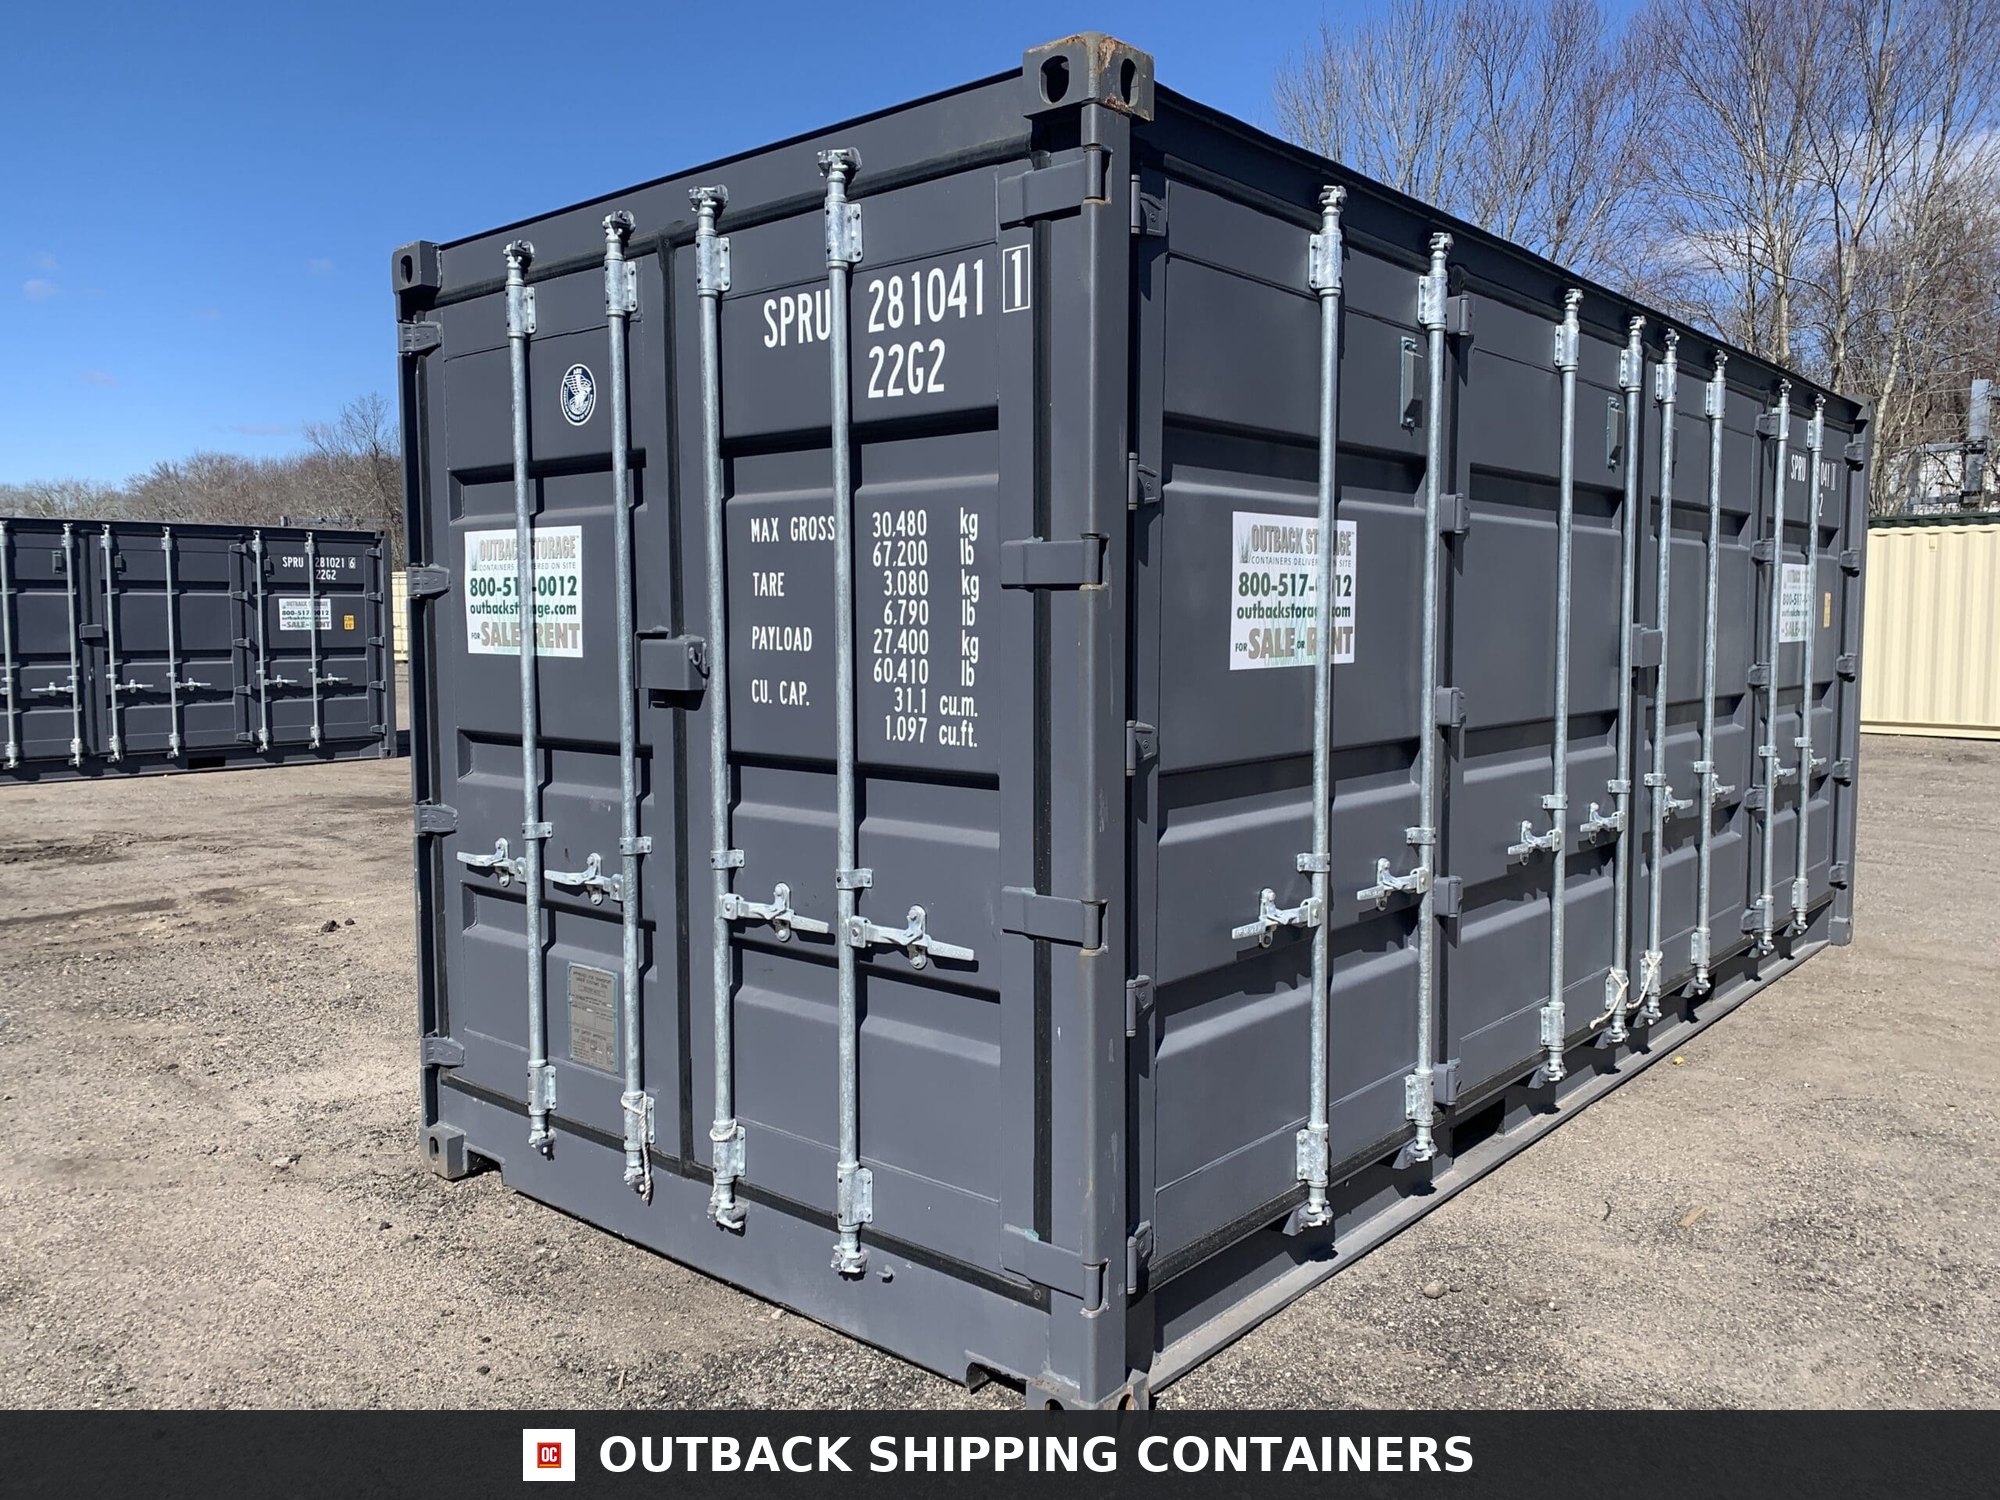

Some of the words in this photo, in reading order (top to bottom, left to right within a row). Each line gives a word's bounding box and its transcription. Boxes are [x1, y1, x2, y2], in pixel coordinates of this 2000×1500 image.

[763, 289, 831, 348] SPRU
[868, 259, 983, 333] 281041
[868, 338, 946, 398] 22G2
[751, 517, 779, 542] MAX
[790, 515, 835, 541] GROSS
[872, 510, 927, 538] 30,480
[960, 507, 978, 541] kg
[480, 538, 518, 561] OUTBAC
[873, 540, 928, 567] 67,200
[960, 538, 974, 565] lb
[1251, 524, 1304, 554] OUTBACK
[1306, 528, 1351, 556] STAGE
[282, 556, 304, 568] SPRU
[315, 557, 345, 569] 281021
[348, 557, 356, 569] 6
[316, 570, 337, 580] 22G2
[479, 563, 514, 572] CONTAINERS
[551, 562, 560, 570] ON
[562, 561, 576, 569] SITE
[1251, 555, 1292, 566] CONTAINERS
[1293, 556, 1318, 567] DELIVER
[1339, 560, 1351, 568] SITE
[470, 575, 577, 597] 800-51-0012
[753, 572, 785, 597] TARE
[884, 570, 928, 596] 3,080
[961, 569, 979, 603] kg
[1238, 572, 1352, 597] 800-517-12
[470, 600, 577, 618] outbackstage.com
[884, 599, 929, 625] 6,790
[962, 599, 975, 626] lb
[471, 632, 480, 640] FOR
[481, 621, 520, 647] SALE
[533, 622, 581, 649] RENT
[752, 626, 812, 652] PAYLOAD
[873, 629, 929, 655] 27,400
[961, 630, 979, 663] kg
[1235, 643, 1247, 652] FOR
[1248, 627, 1295, 660] SALE
[1297, 641, 1305, 649] OR
[1307, 626, 1353, 657] RNT
[873, 658, 929, 684] 60,410
[961, 660, 975, 687] lb
[751, 679, 772, 704] CU.
[779, 681, 810, 706] CAP.
[894, 687, 926, 714] 31.1
[939, 694, 978, 717] cu.m.
[885, 715, 928, 743] 1,097
[939, 720, 978, 747] cu.ft.
